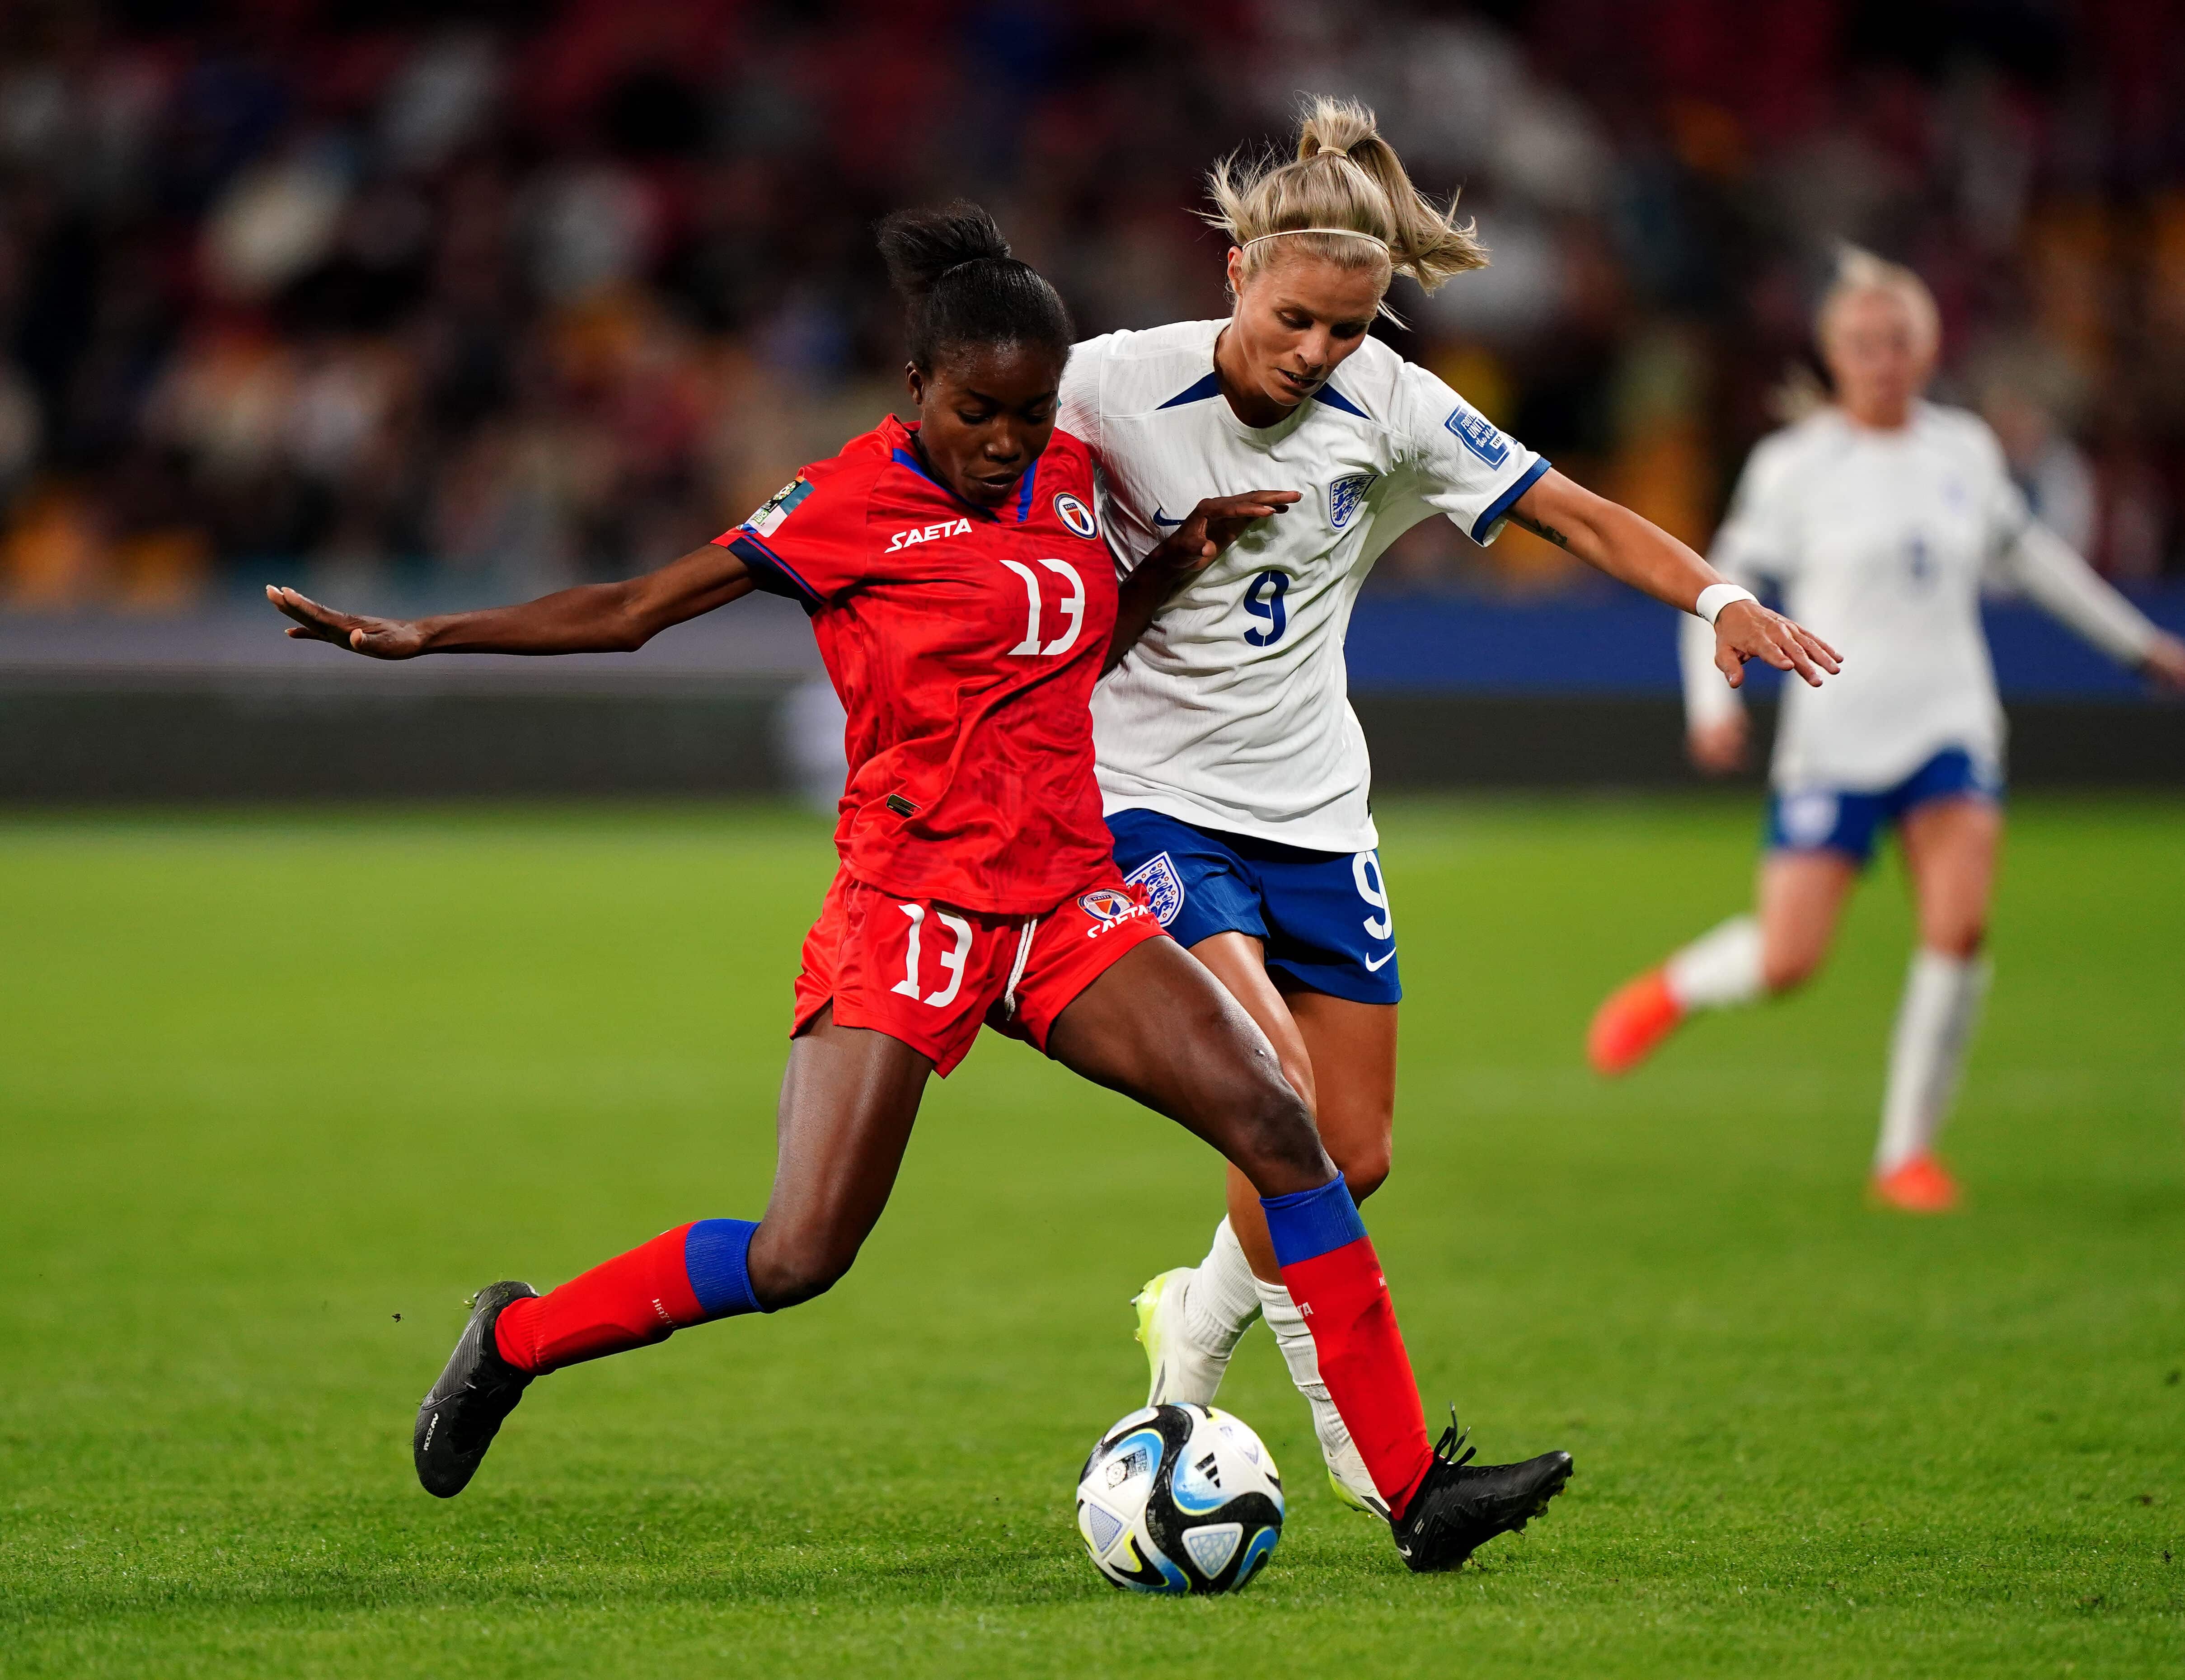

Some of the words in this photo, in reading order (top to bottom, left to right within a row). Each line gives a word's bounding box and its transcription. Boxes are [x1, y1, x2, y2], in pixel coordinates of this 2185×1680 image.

[1492, 436, 1502, 446] FIFA
[884, 518, 973, 554] SAETA
[999, 558, 1086, 656] 13
[1244, 569, 1289, 647] 9
[1352, 849, 1393, 940] 9
[890, 903, 973, 1008] 13
